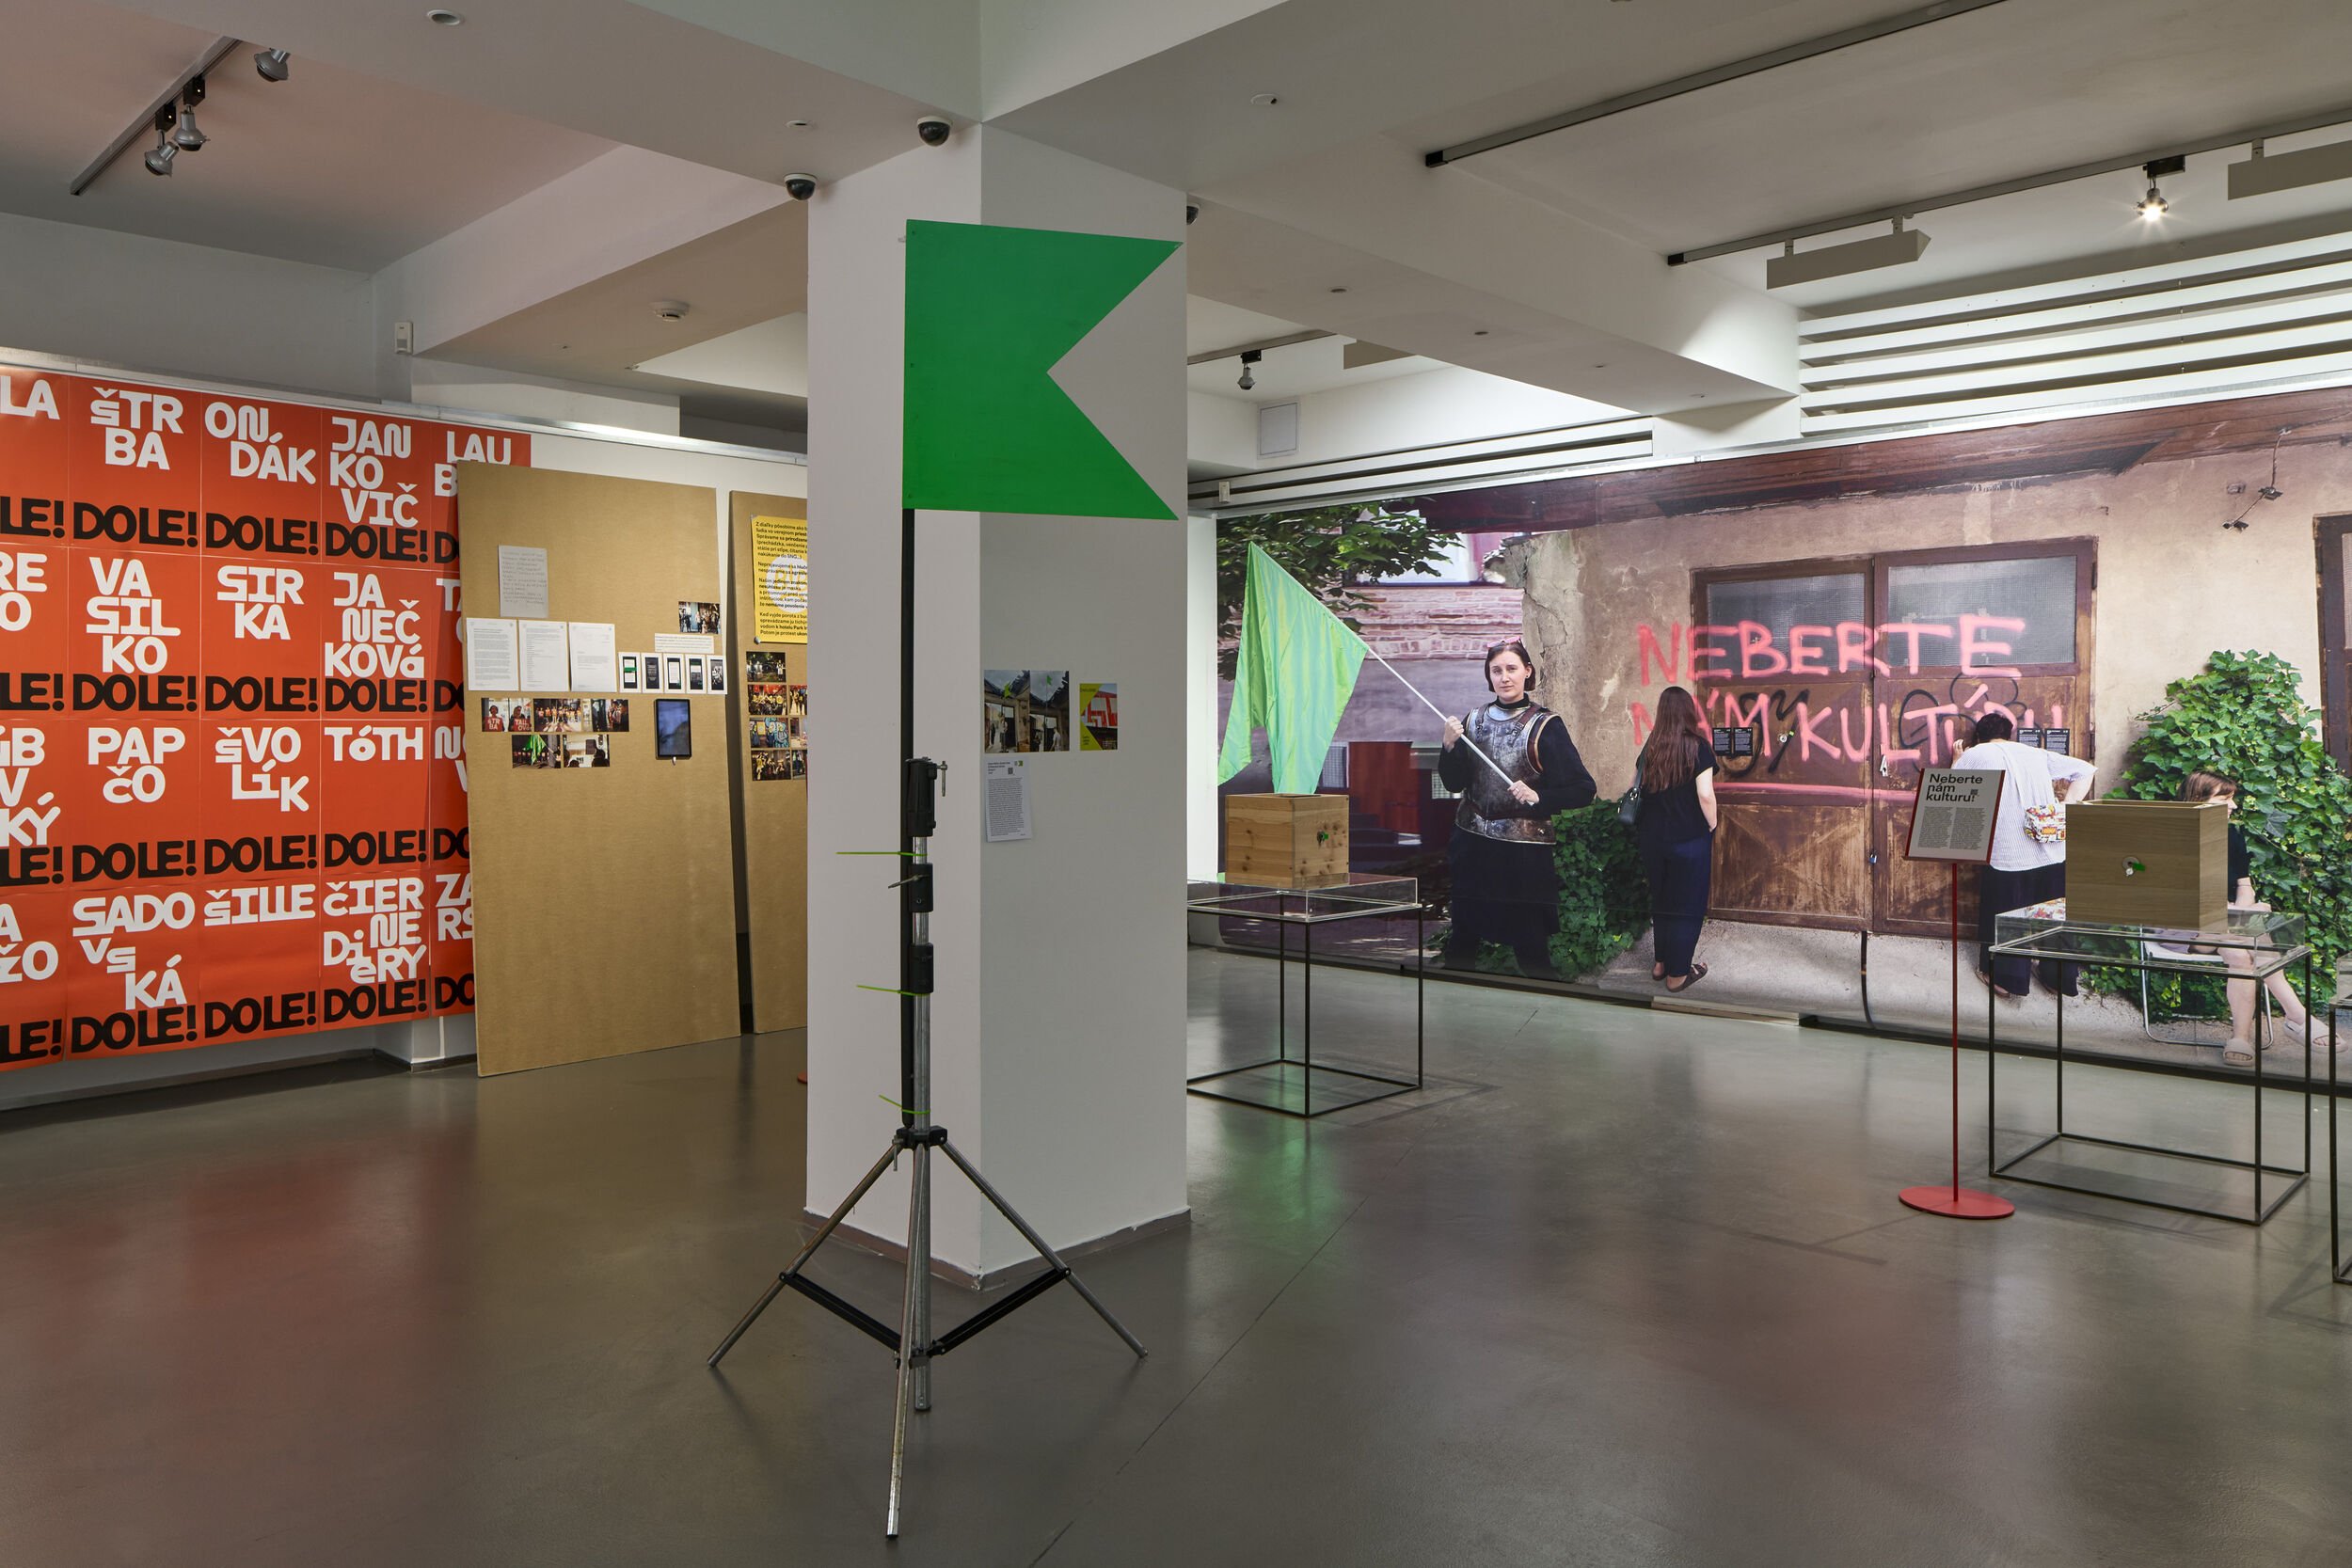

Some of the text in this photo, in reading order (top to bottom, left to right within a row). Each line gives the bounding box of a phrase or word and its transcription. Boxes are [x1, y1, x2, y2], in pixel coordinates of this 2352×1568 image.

[205, 403, 268, 442] ON
[331, 417, 411, 458] JAN
[105, 428, 169, 469] BA
[230, 433, 316, 484] DÁK
[447, 431, 511, 465] LAU
[330, 452, 383, 490] KO
[74, 502, 198, 546] DOLE!
[342, 483, 418, 528] VIČ
[206, 513, 318, 555] DOLE!
[326, 523, 428, 562] DOLE!
[89, 557, 152, 597] VA
[217, 565, 304, 605] SIR
[334, 572, 385, 608] JA
[87, 597, 181, 636] SIL
[235, 603, 291, 640] KA
[342, 600, 421, 643] NEČ
[103, 636, 167, 673] KO
[1638, 615, 2025, 686] NEBERTE
[73, 674, 197, 711] DOLE!
[206, 676, 318, 711] DOLE!
[326, 678, 427, 712] DOLE!
[88, 727, 185, 765] PAP
[1926, 792, 1976, 802] kulturu!
[1928, 784, 1956, 793] nám
[1930, 773, 1983, 784] Neberte
[72, 840, 196, 881] DOLE!
[205, 835, 317, 874] DOLE!
[325, 830, 426, 867] DOLE!
[73, 892, 195, 936] SADO
[371, 911, 421, 947] NE
[126, 954, 186, 1010] KÁ
[324, 979, 426, 1022] DOLE!
[71, 1006, 198, 1053] DOLE!
[204, 990, 316, 1038] DOLE!
